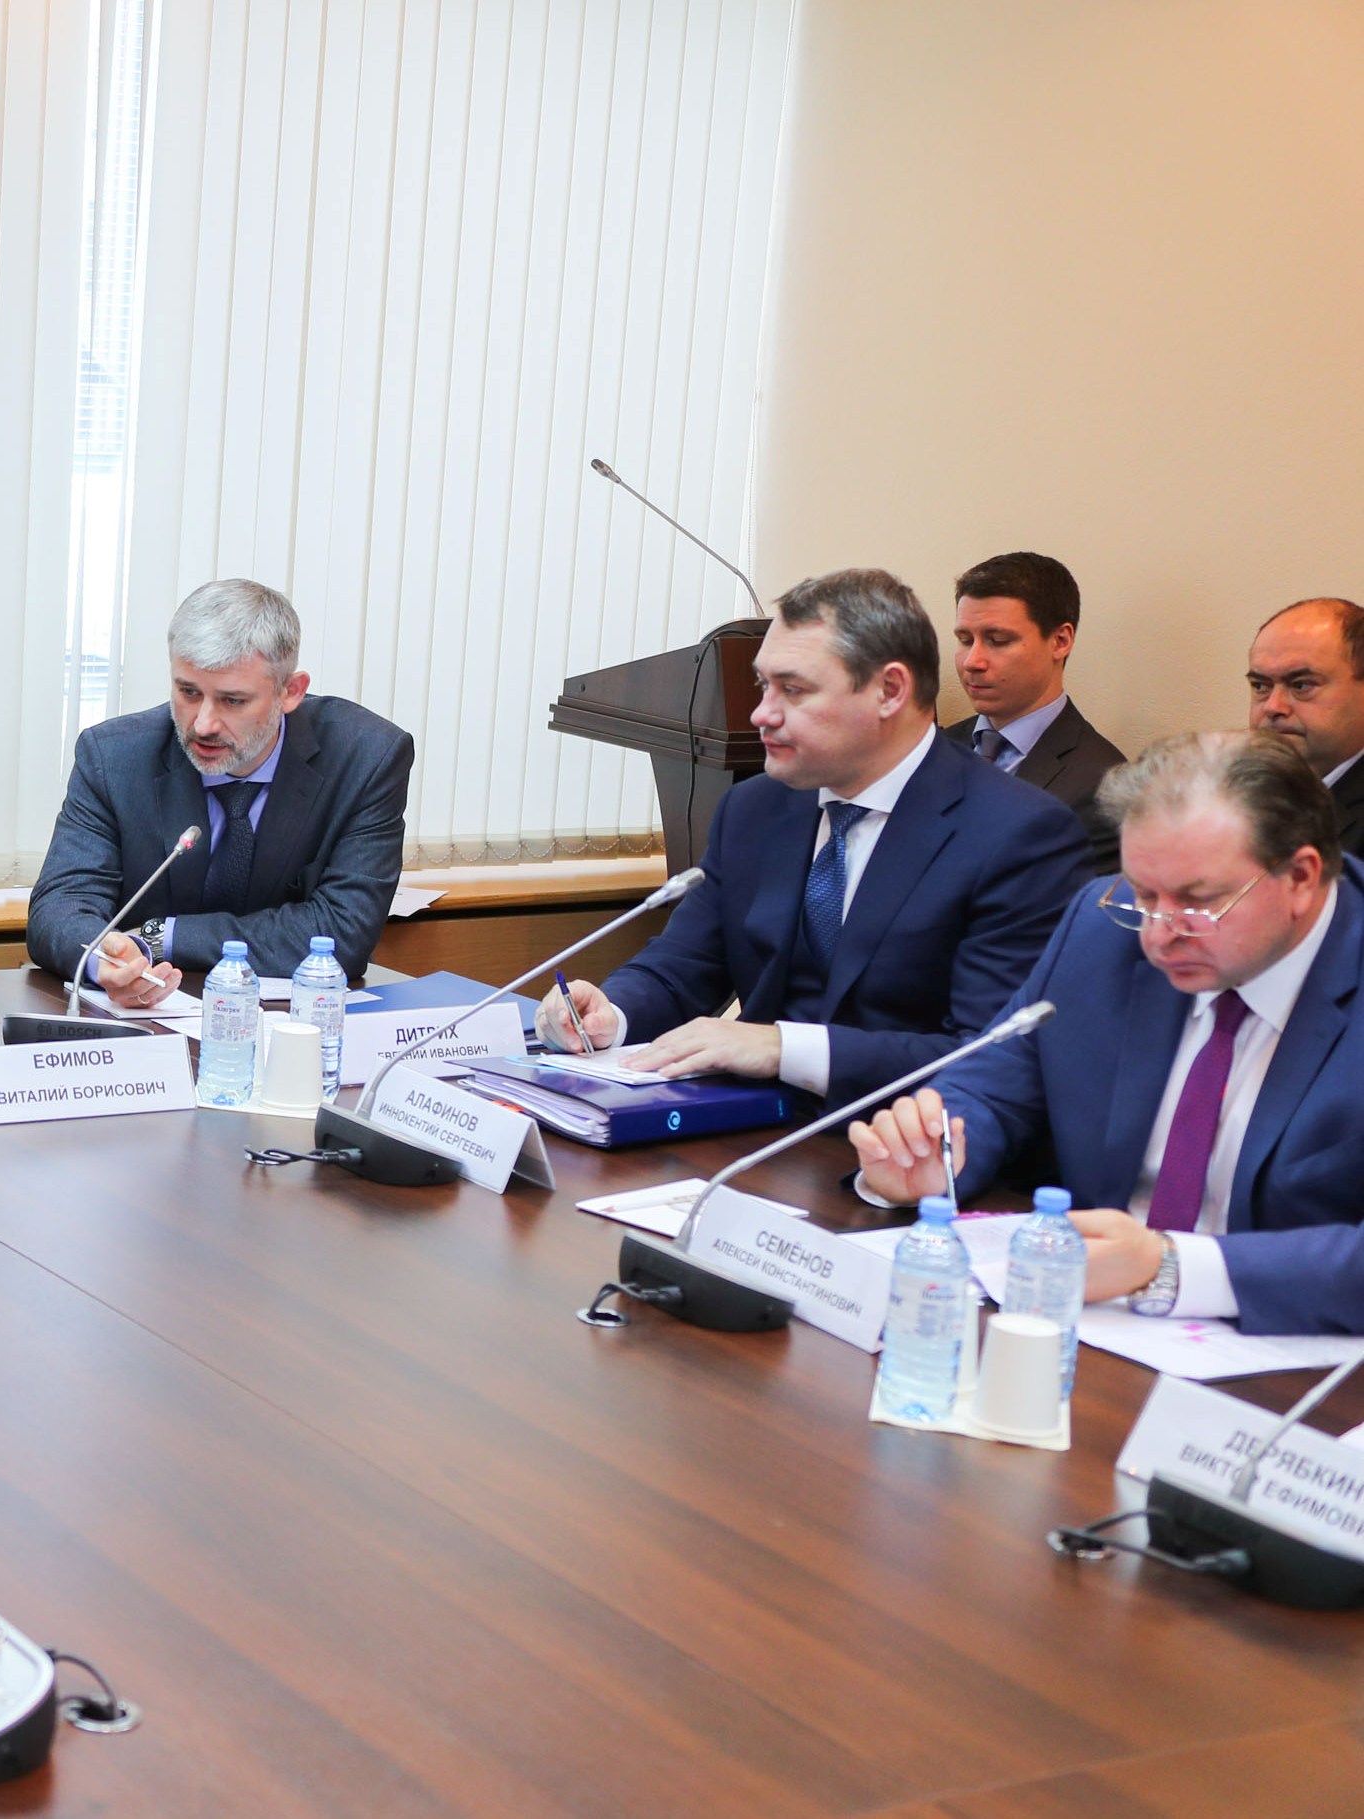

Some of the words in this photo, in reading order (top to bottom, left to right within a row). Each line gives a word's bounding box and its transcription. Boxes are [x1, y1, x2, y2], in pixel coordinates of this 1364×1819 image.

[57, 1025, 103, 1038] BOSCH
[378, 1046, 427, 1061] ЕВГНИЙ
[429, 1045, 489, 1059] ИВАНОВИЧ
[33, 1049, 114, 1069] ЕФИМОВ
[73, 1081, 166, 1100] БОРИСОВИЧ
[405, 1089, 479, 1132] АЛАФИНОВ
[379, 1101, 440, 1138] ИННОКЕНТИЙ
[439, 1129, 497, 1163] СЕРГЕЕВИЧ
[756, 1230, 836, 1281] СЕМЁНОВ
[760, 1260, 863, 1320] КОНСТАНТИНОВИЧ
[1179, 1443, 1248, 1486] ВИКТО
